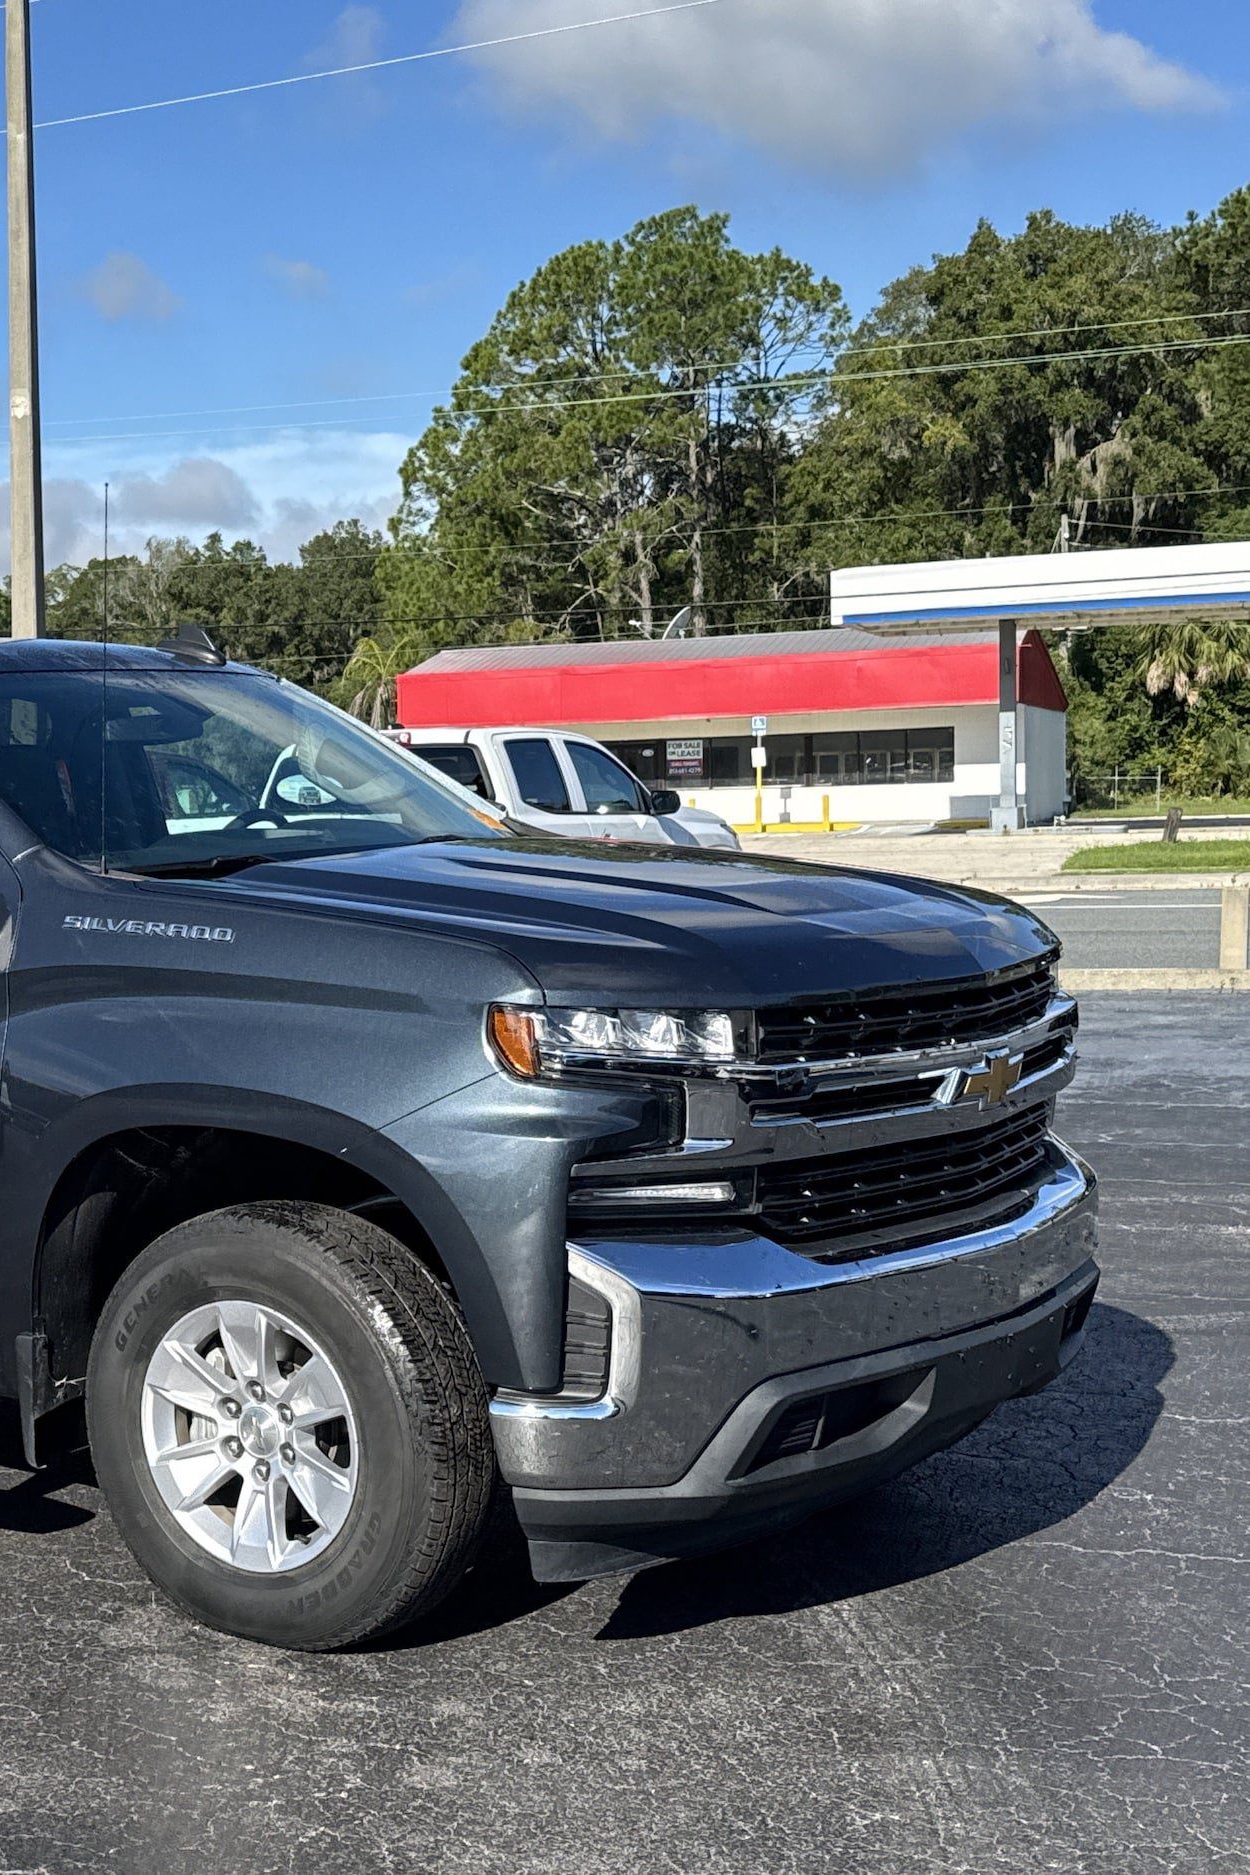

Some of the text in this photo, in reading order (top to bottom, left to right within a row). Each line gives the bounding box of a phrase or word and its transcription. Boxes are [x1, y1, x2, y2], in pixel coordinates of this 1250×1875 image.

[668, 741, 701, 750] FOR SALE
[677, 749, 701, 757] LEASE
[62, 915, 236, 943] SILVERADO
[287, 1511, 382, 1615] GRABBER
